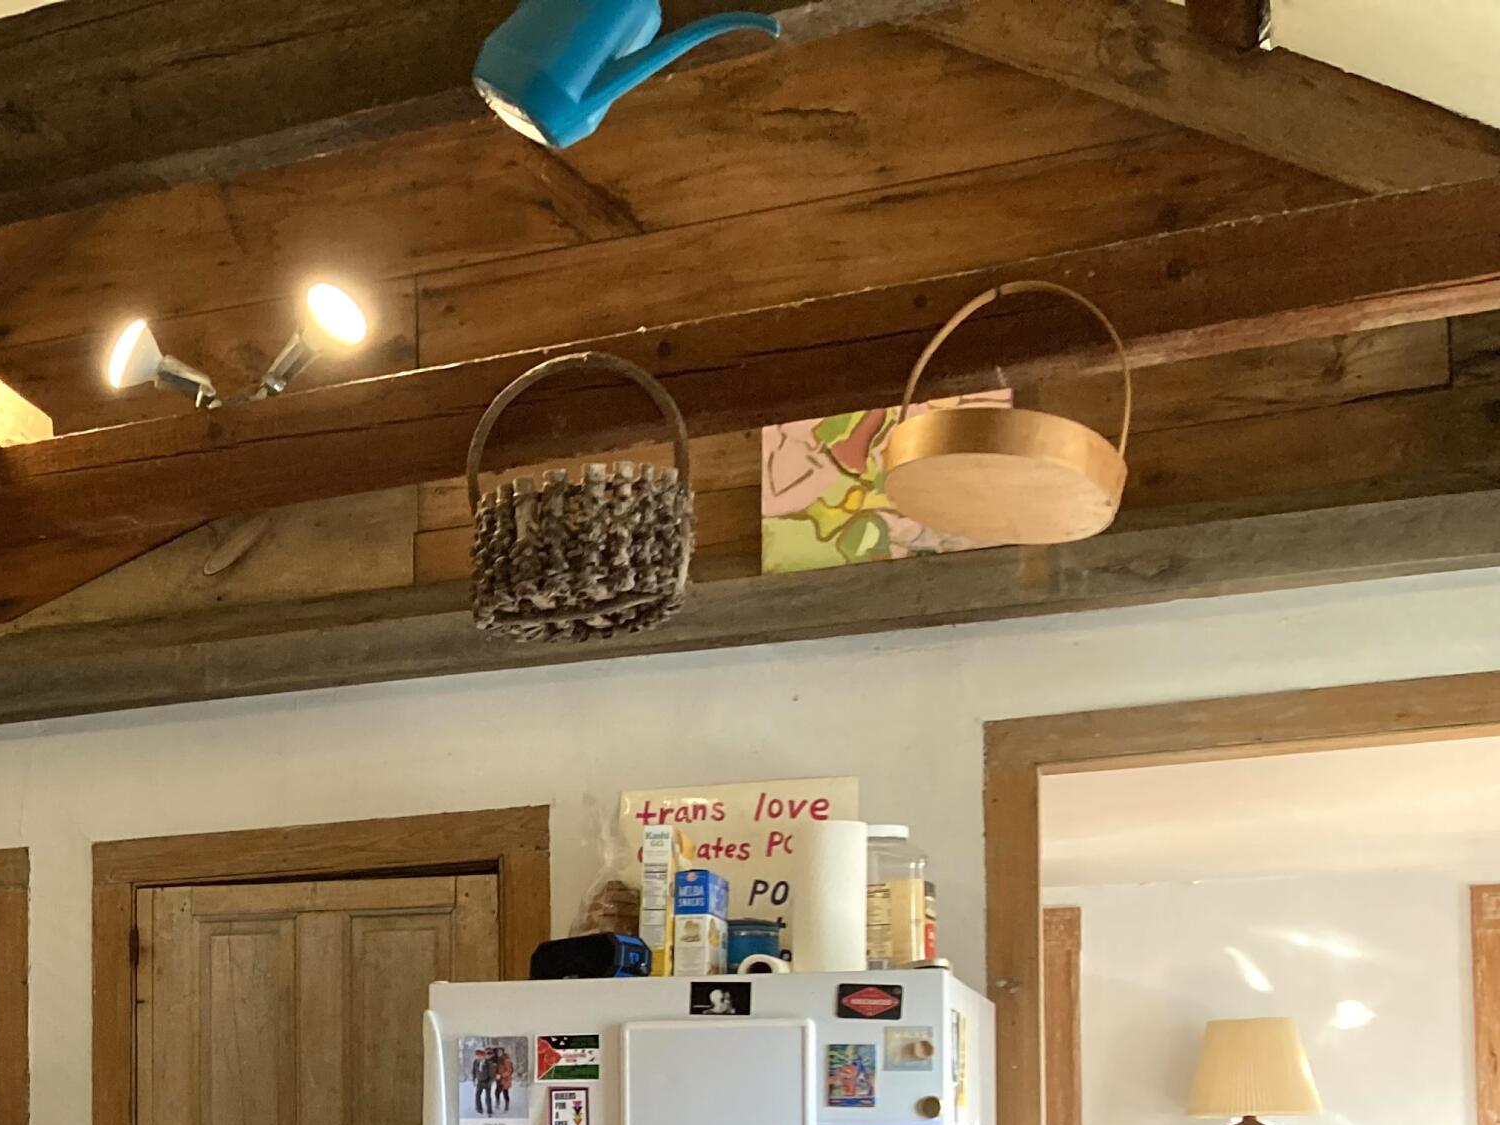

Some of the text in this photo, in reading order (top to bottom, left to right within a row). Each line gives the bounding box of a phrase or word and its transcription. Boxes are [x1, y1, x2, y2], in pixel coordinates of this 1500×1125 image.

[636, 792, 830, 825] trans love
[554, 1092, 576, 1100] QUEERS
[554, 1102, 566, 1110] FOR
